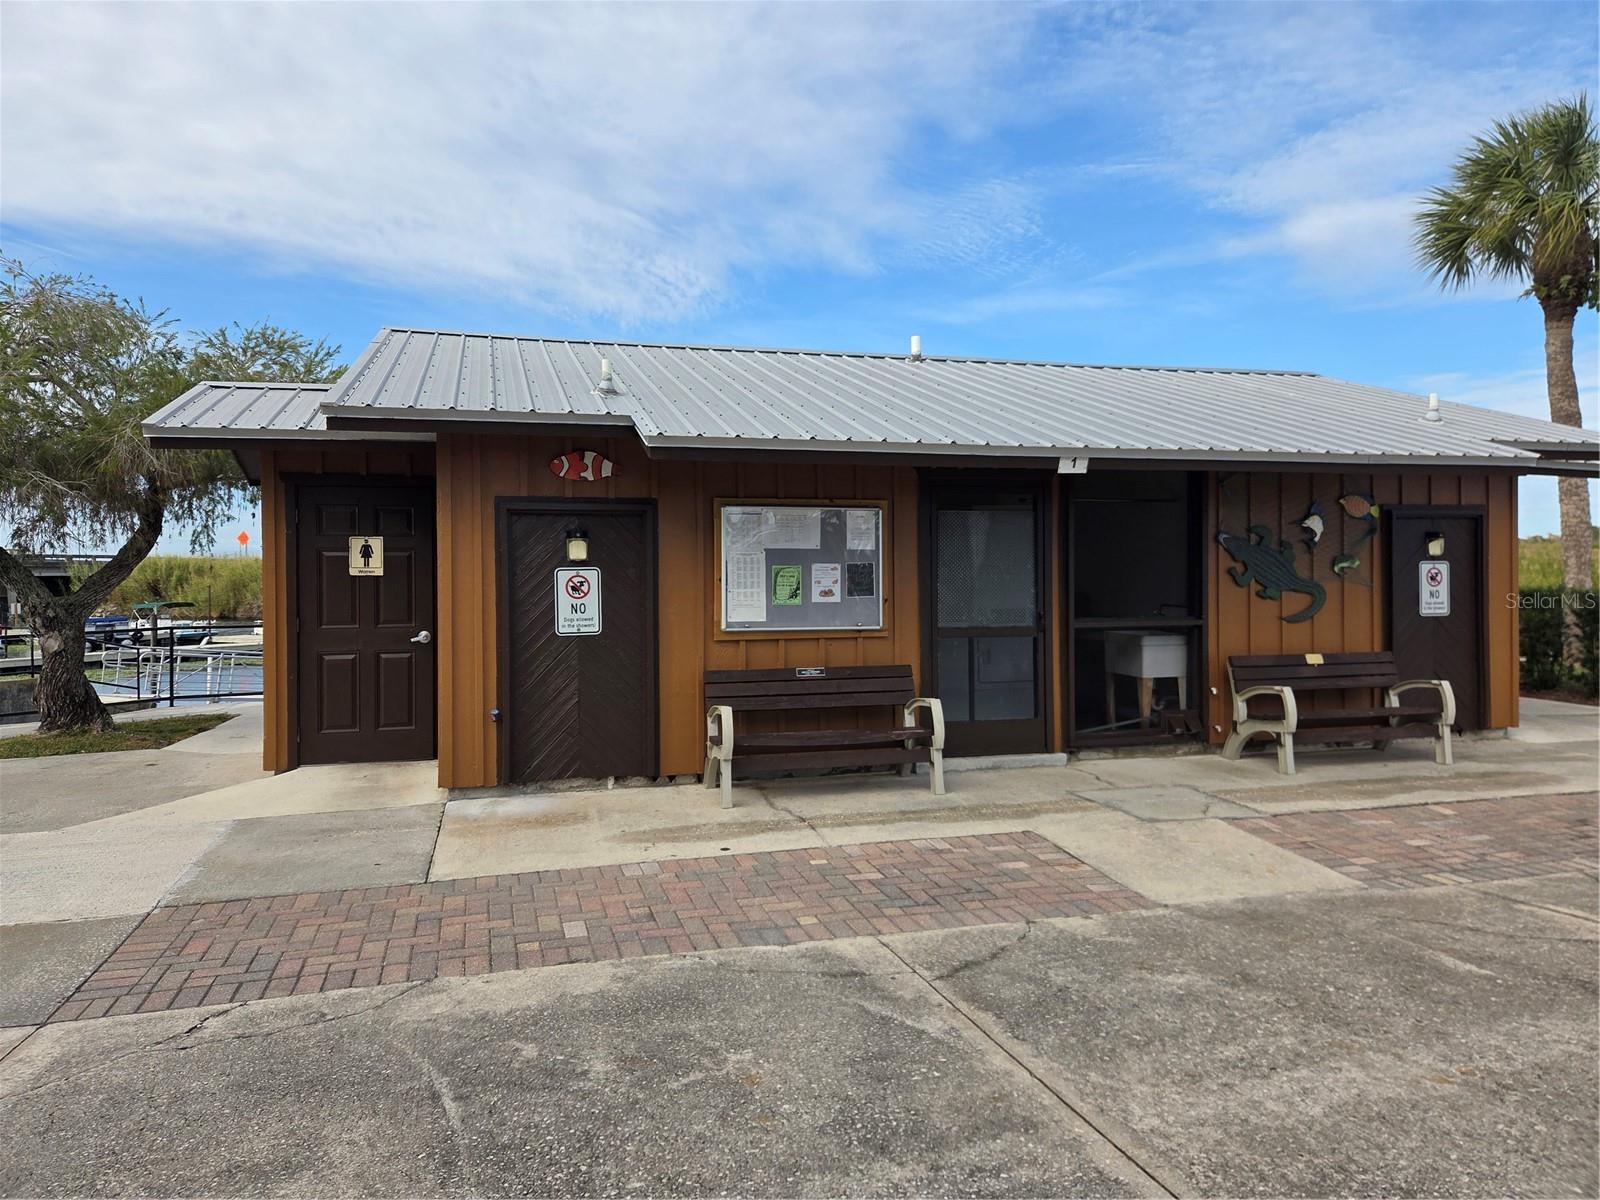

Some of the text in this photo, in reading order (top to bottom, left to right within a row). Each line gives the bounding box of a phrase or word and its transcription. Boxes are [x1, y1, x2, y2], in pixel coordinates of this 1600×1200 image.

[1071, 457, 1077, 469] 1
[1430, 590, 1440, 600] NO
[570, 603, 586, 614] NO
